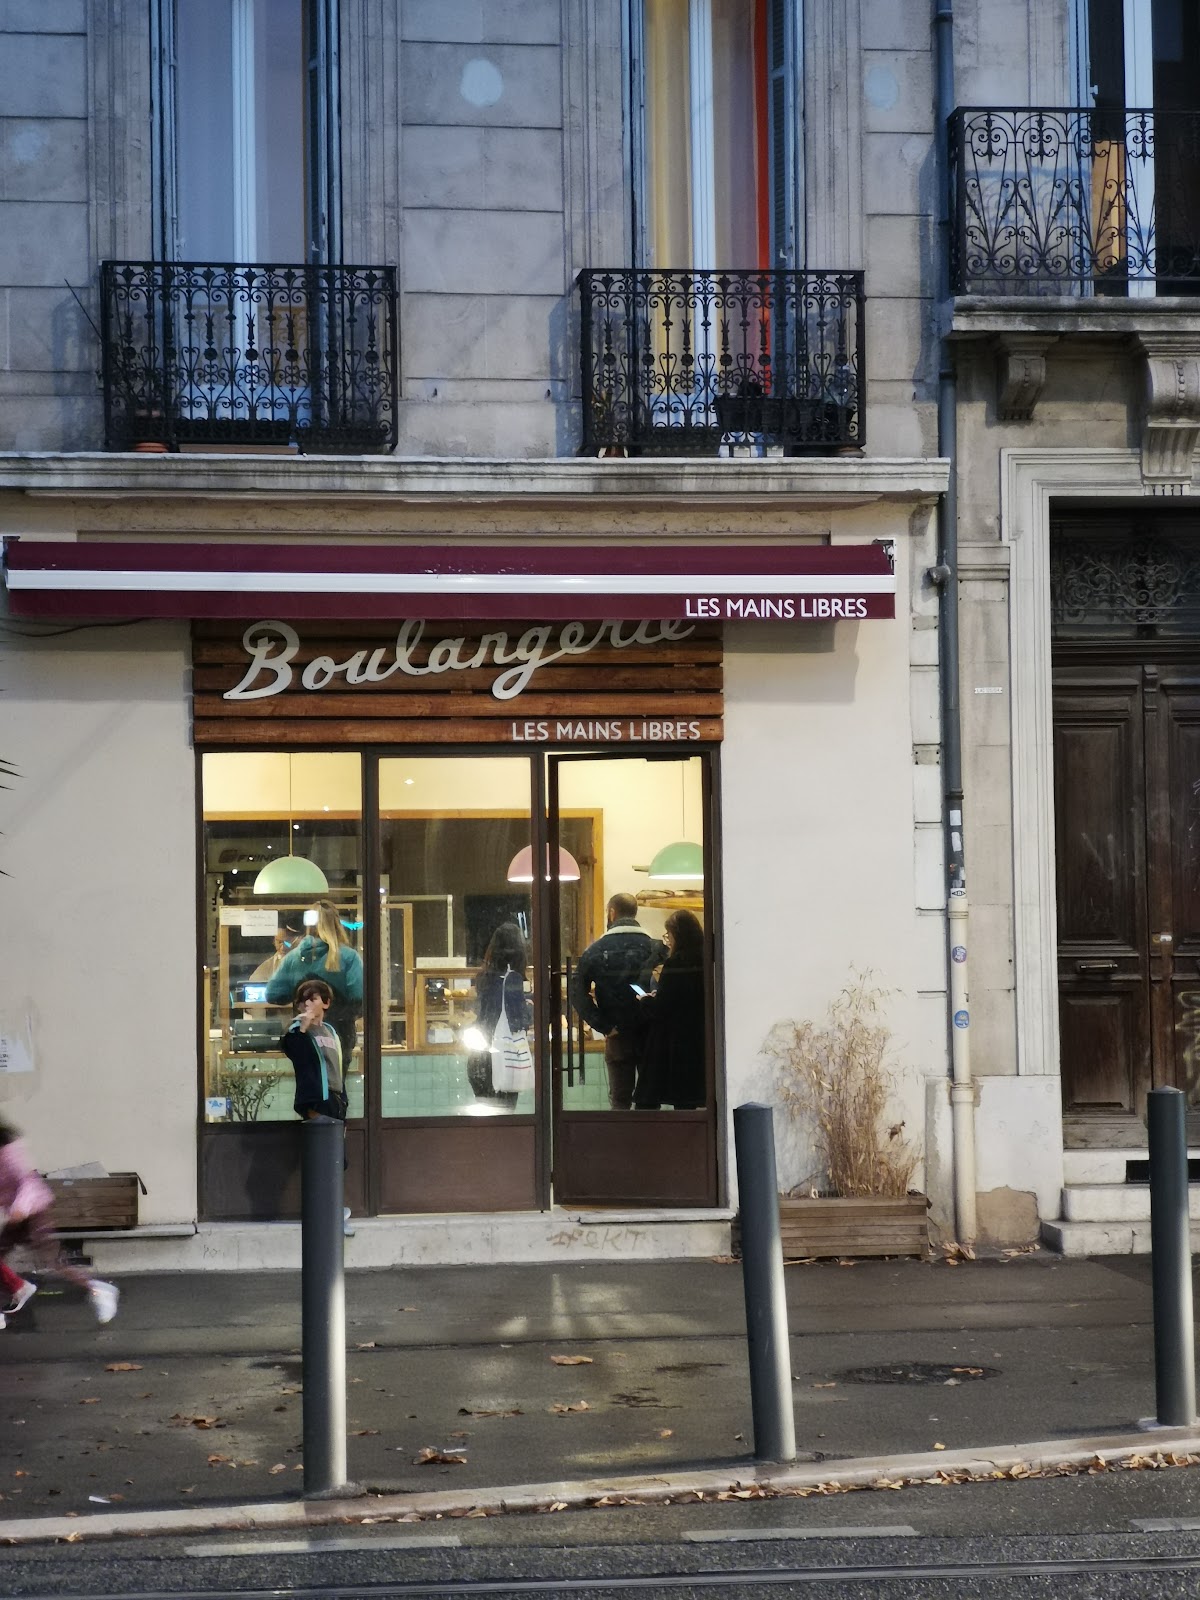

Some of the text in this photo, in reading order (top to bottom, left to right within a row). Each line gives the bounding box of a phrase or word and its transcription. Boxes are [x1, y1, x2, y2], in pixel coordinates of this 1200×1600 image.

[685, 598, 868, 619] LES MAINS LIBRES
[511, 720, 701, 741] LES MAINS LIBRES
